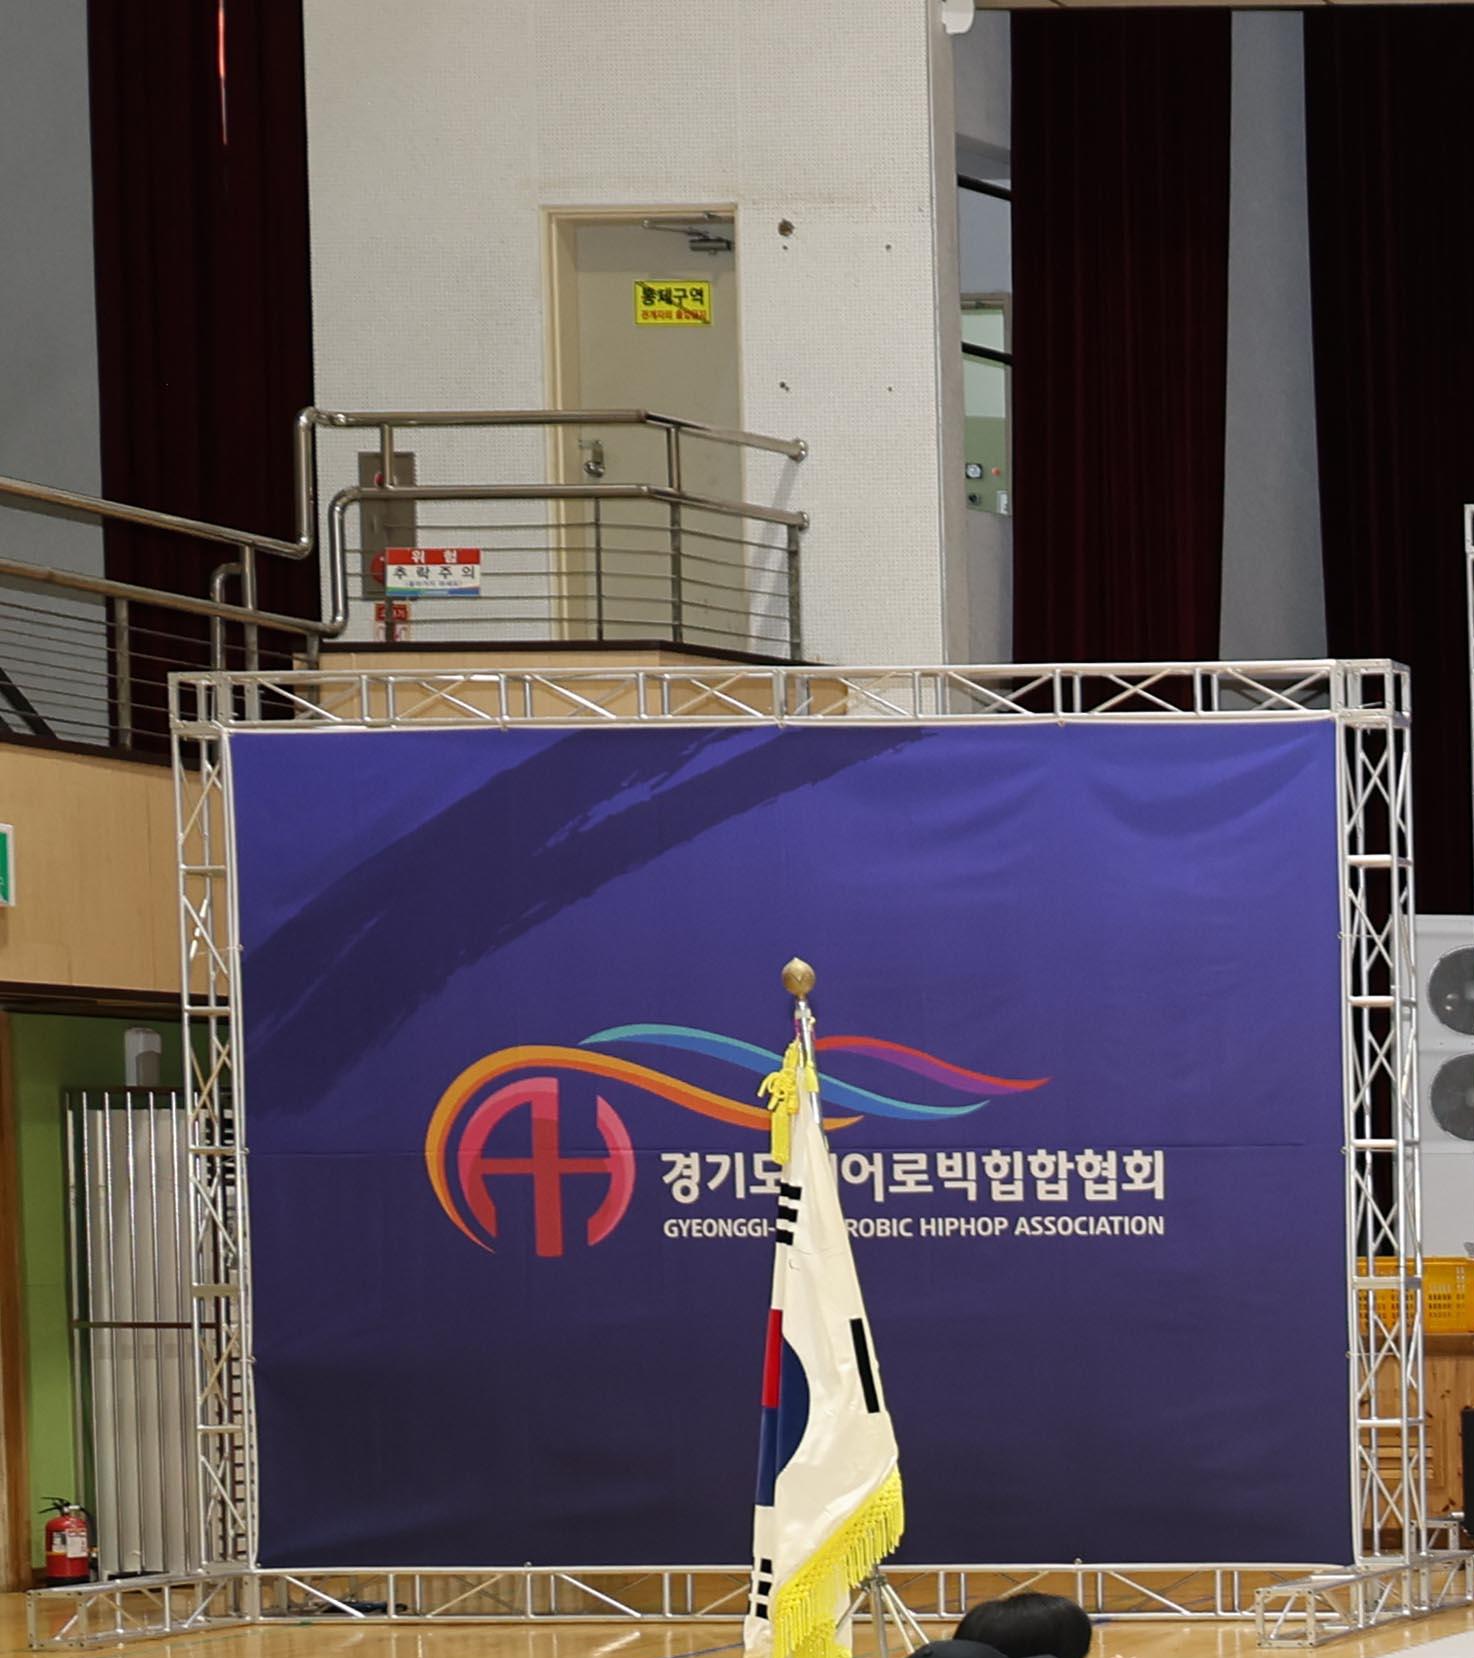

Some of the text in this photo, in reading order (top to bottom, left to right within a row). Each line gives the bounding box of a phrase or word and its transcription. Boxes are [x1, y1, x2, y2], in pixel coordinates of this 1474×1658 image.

[661, 1149, 1164, 1204] 경기도어로빅힙합협회
[920, 1217, 1009, 1236] HIPHOP
[1014, 1216, 1164, 1235] ASSOCIATION
